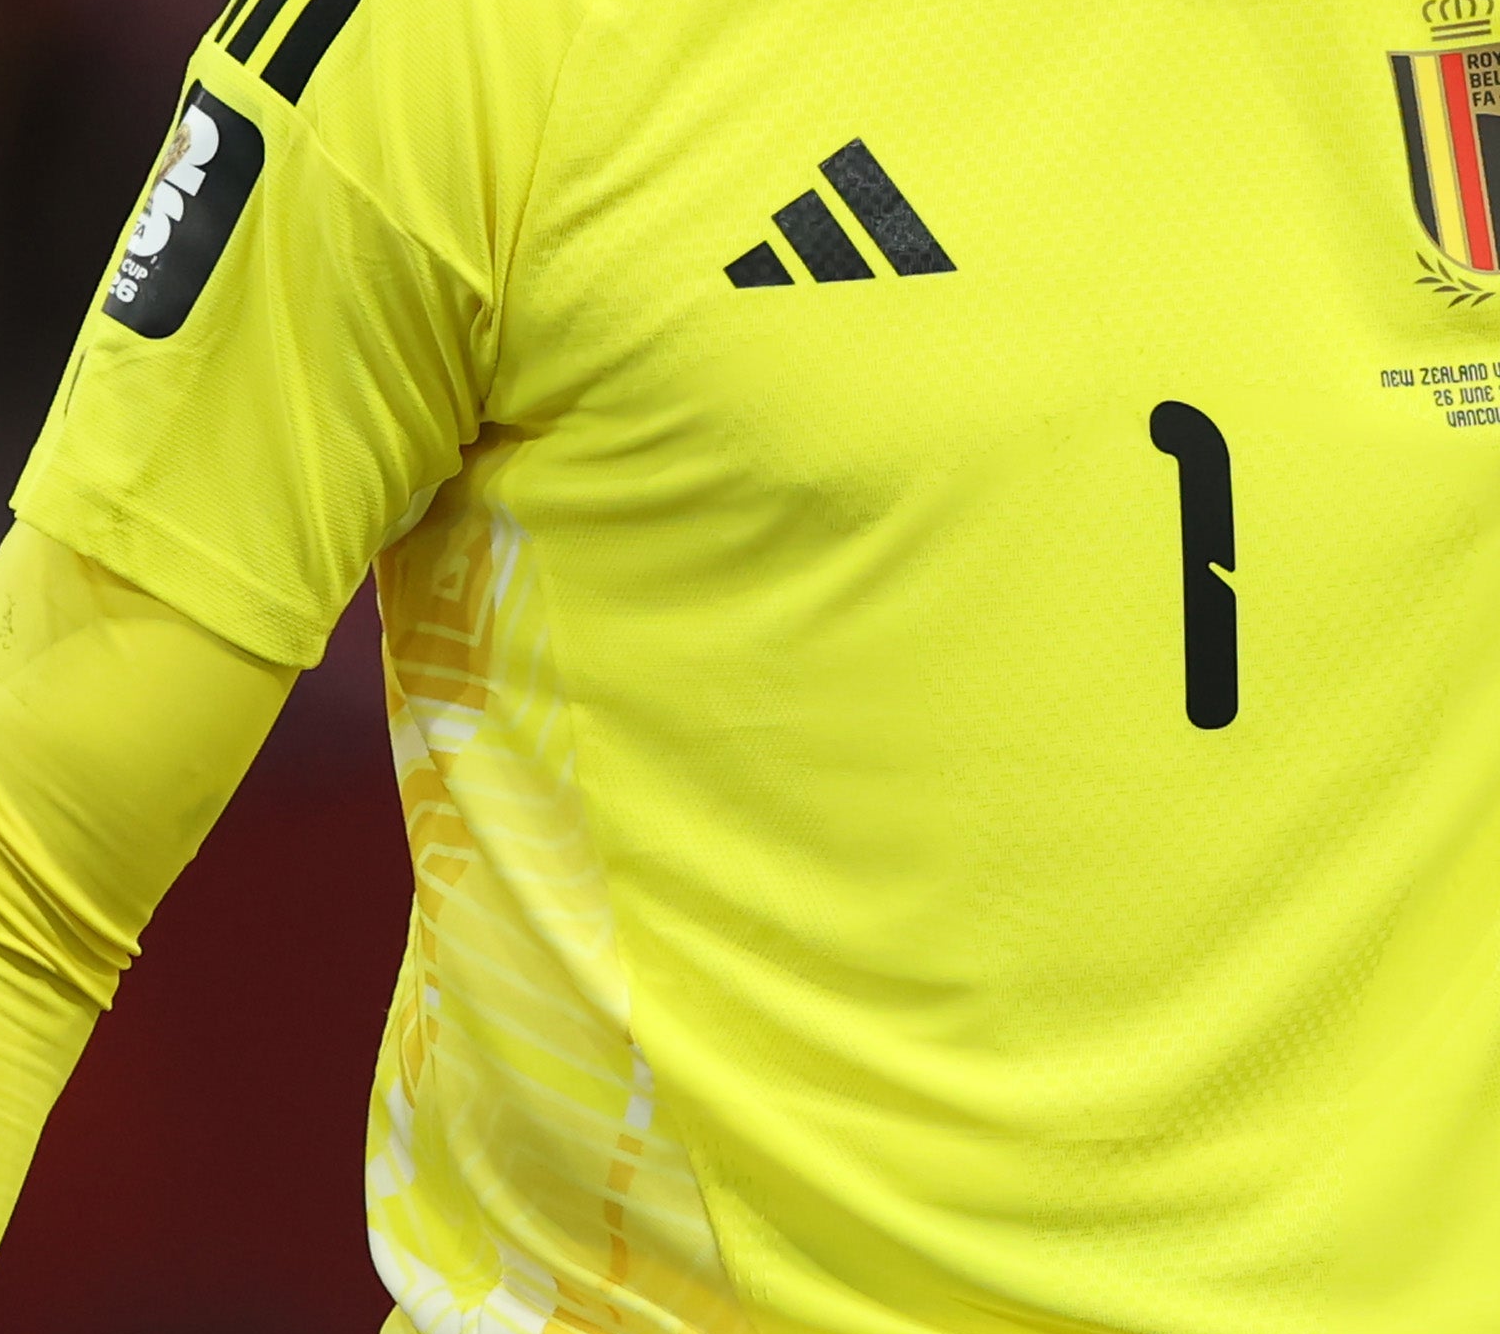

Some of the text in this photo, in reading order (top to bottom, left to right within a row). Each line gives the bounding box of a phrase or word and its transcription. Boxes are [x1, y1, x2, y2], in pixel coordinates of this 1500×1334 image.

[1472, 91, 1496, 107] FA
[121, 258, 149, 280] CUP
[1381, 368, 1415, 388] NEW
[1420, 362, 1489, 386] ZEALAND
[1433, 390, 1454, 407] 26
[1460, 385, 1495, 406] JUNE
[1149, 400, 1239, 730] 1
